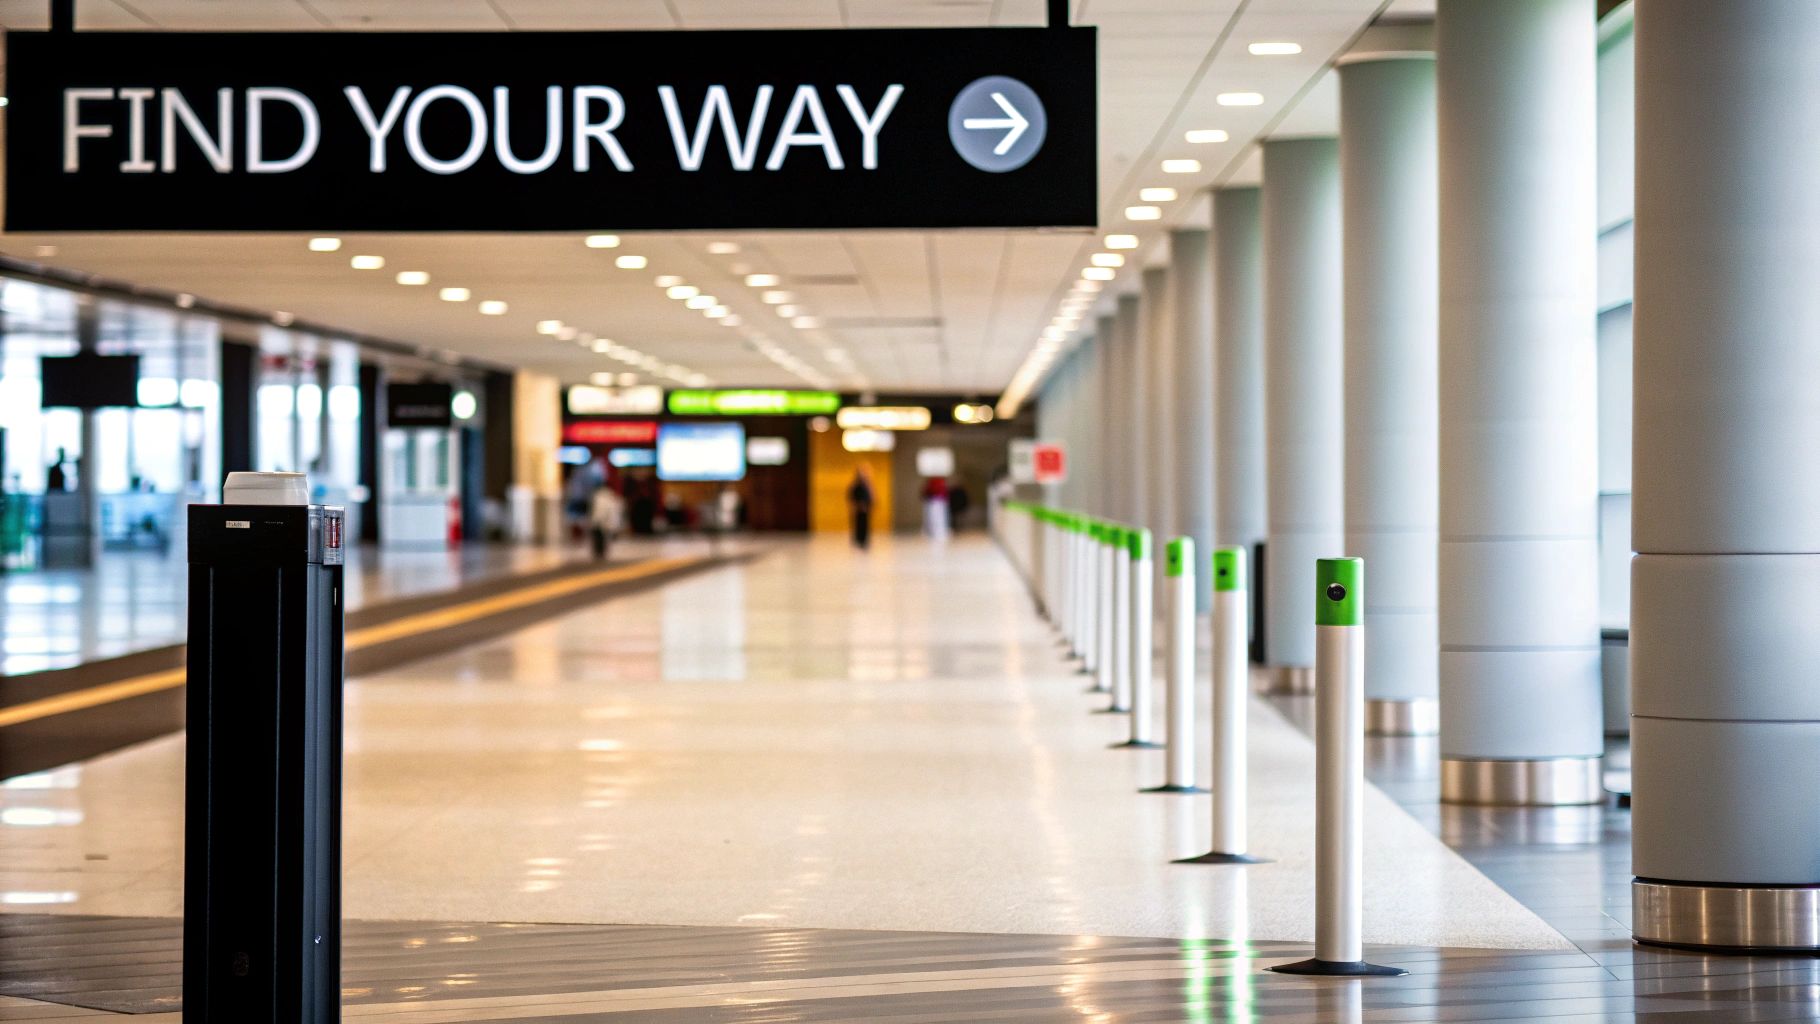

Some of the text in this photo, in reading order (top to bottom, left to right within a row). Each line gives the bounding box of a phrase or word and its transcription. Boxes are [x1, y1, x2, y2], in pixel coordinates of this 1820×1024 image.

[63, 83, 905, 175] FIND YOUR WAY
